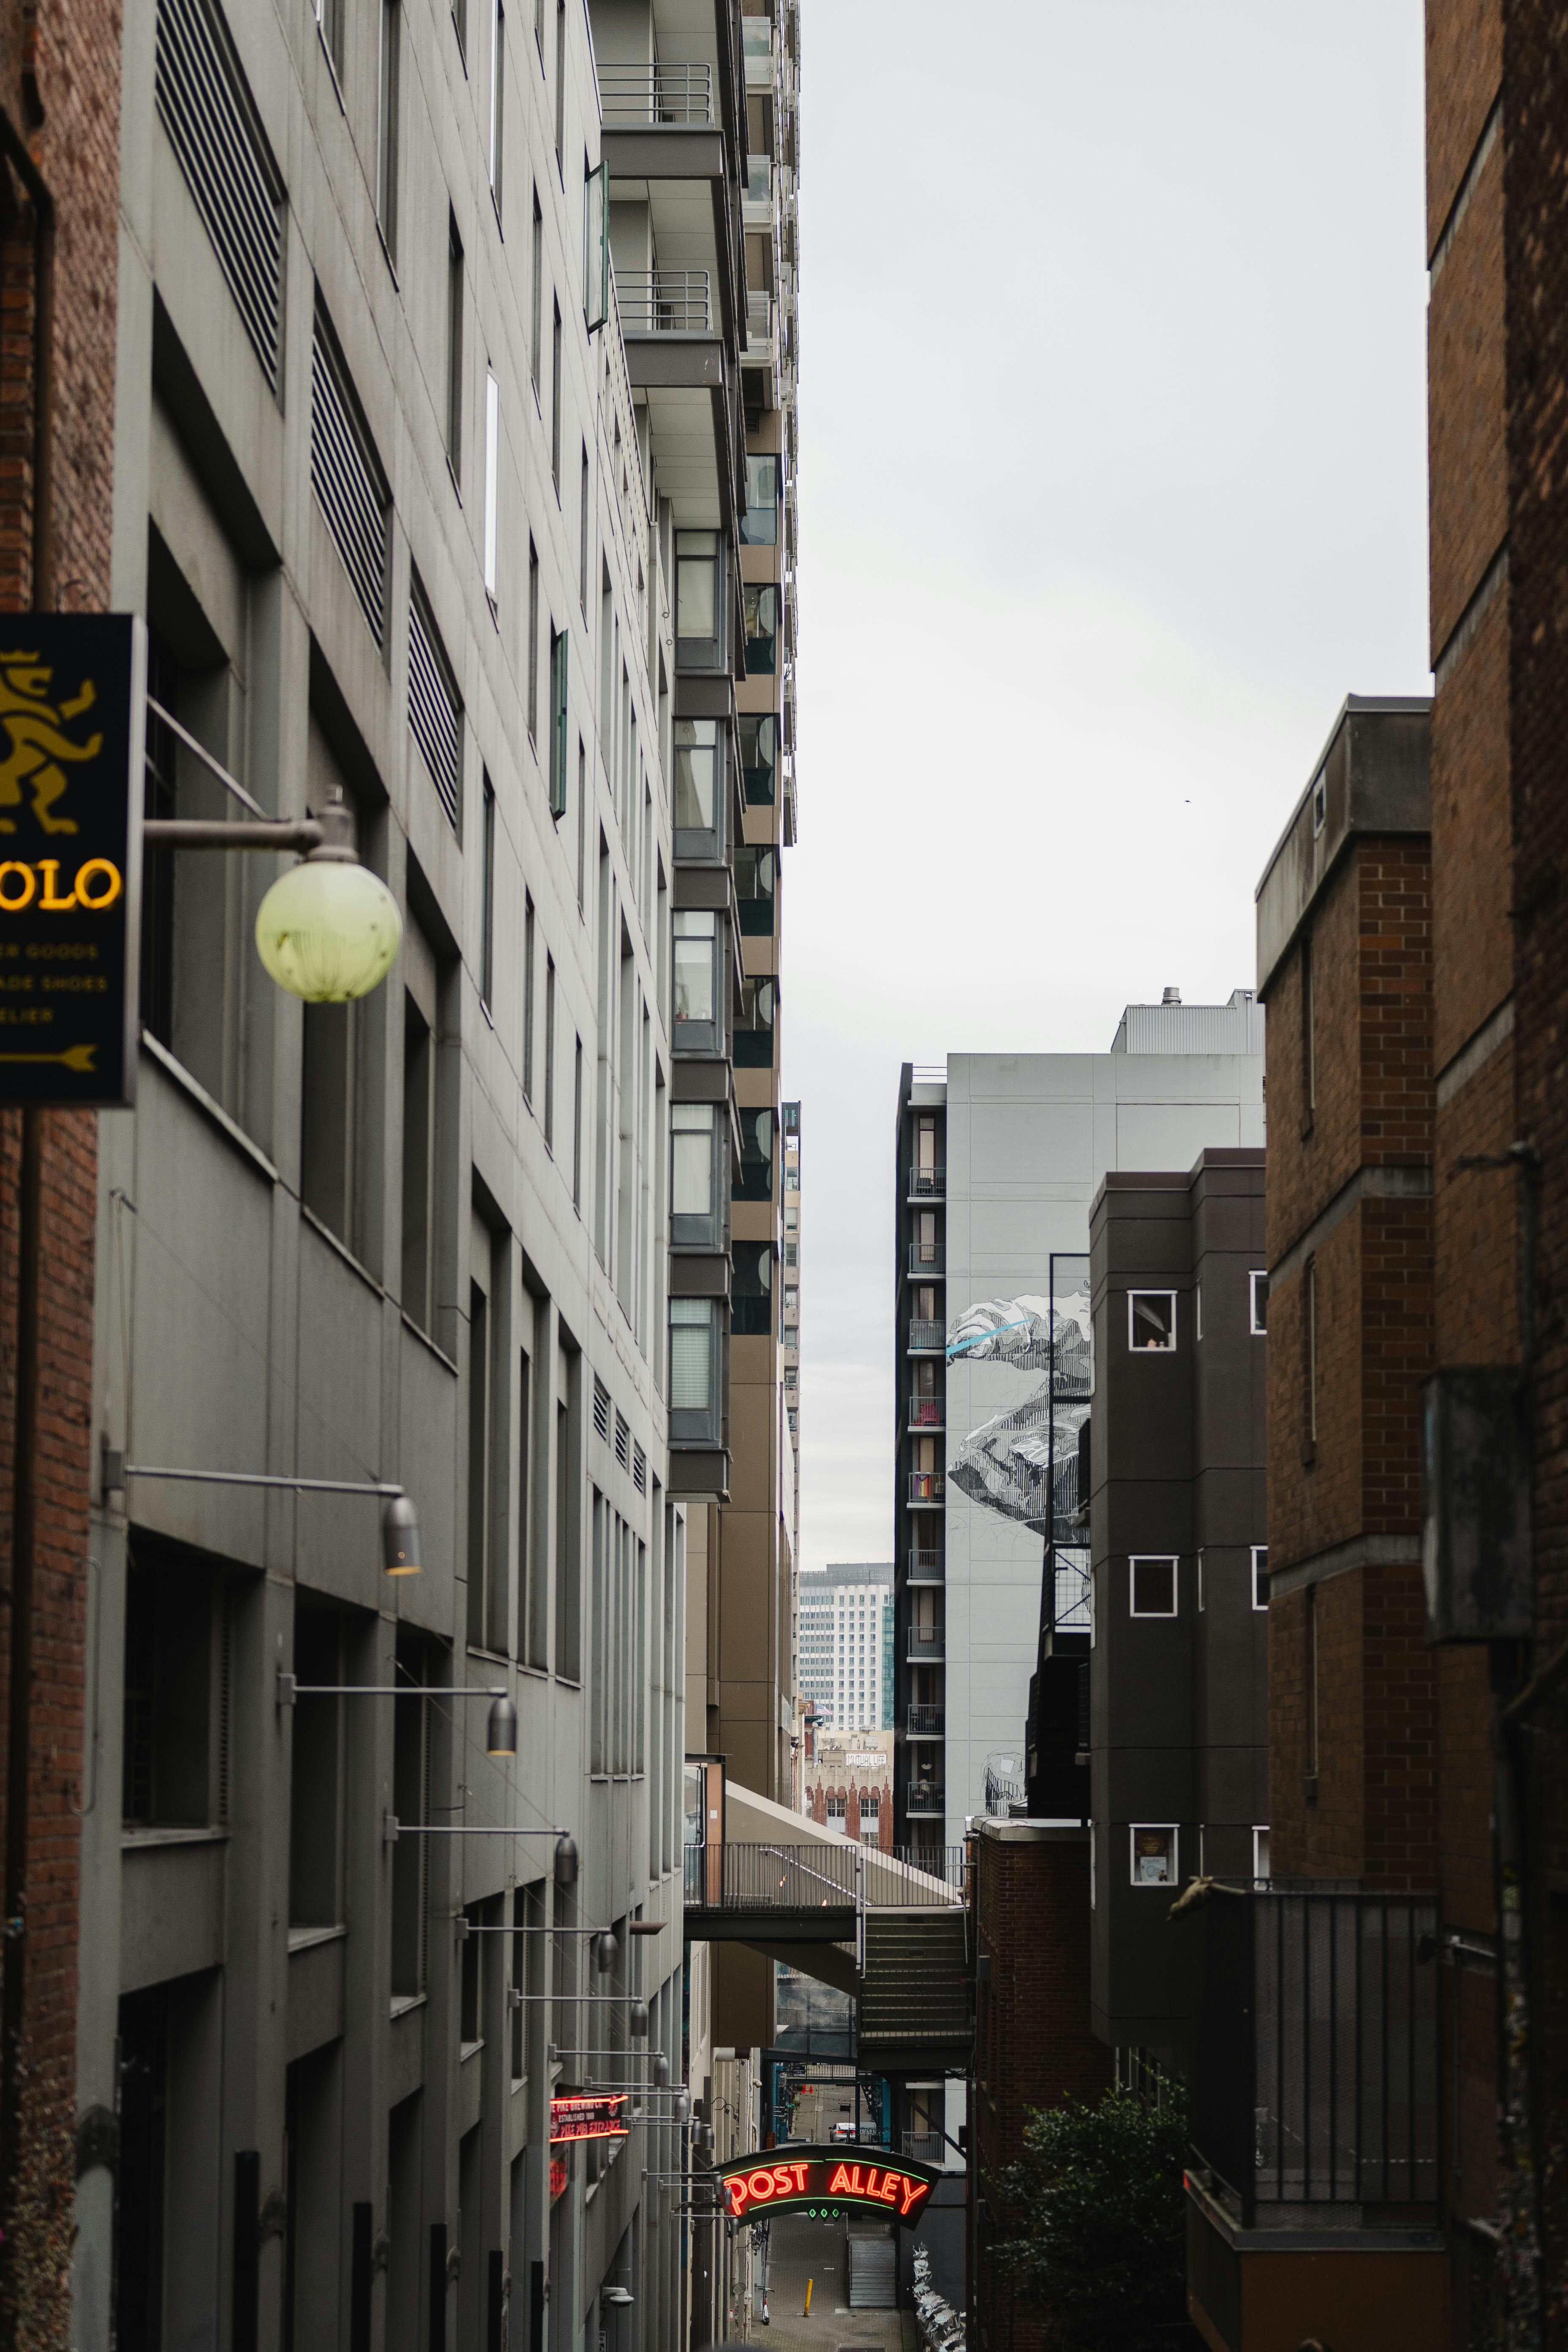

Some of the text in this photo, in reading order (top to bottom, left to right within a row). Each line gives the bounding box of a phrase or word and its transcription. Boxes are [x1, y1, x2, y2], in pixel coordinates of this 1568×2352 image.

[25, 942, 99, 961] GOODS
[41, 975, 108, 993] SHOES
[848, 1755, 871, 1765] MUTUAL
[557, 2102, 569, 2112] PIKE
[558, 2113, 585, 2123] ESTABLISHED
[560, 2119, 620, 2137] PIKE PUB ENTRANCE
[723, 2162, 928, 2216] POST ALLEY
